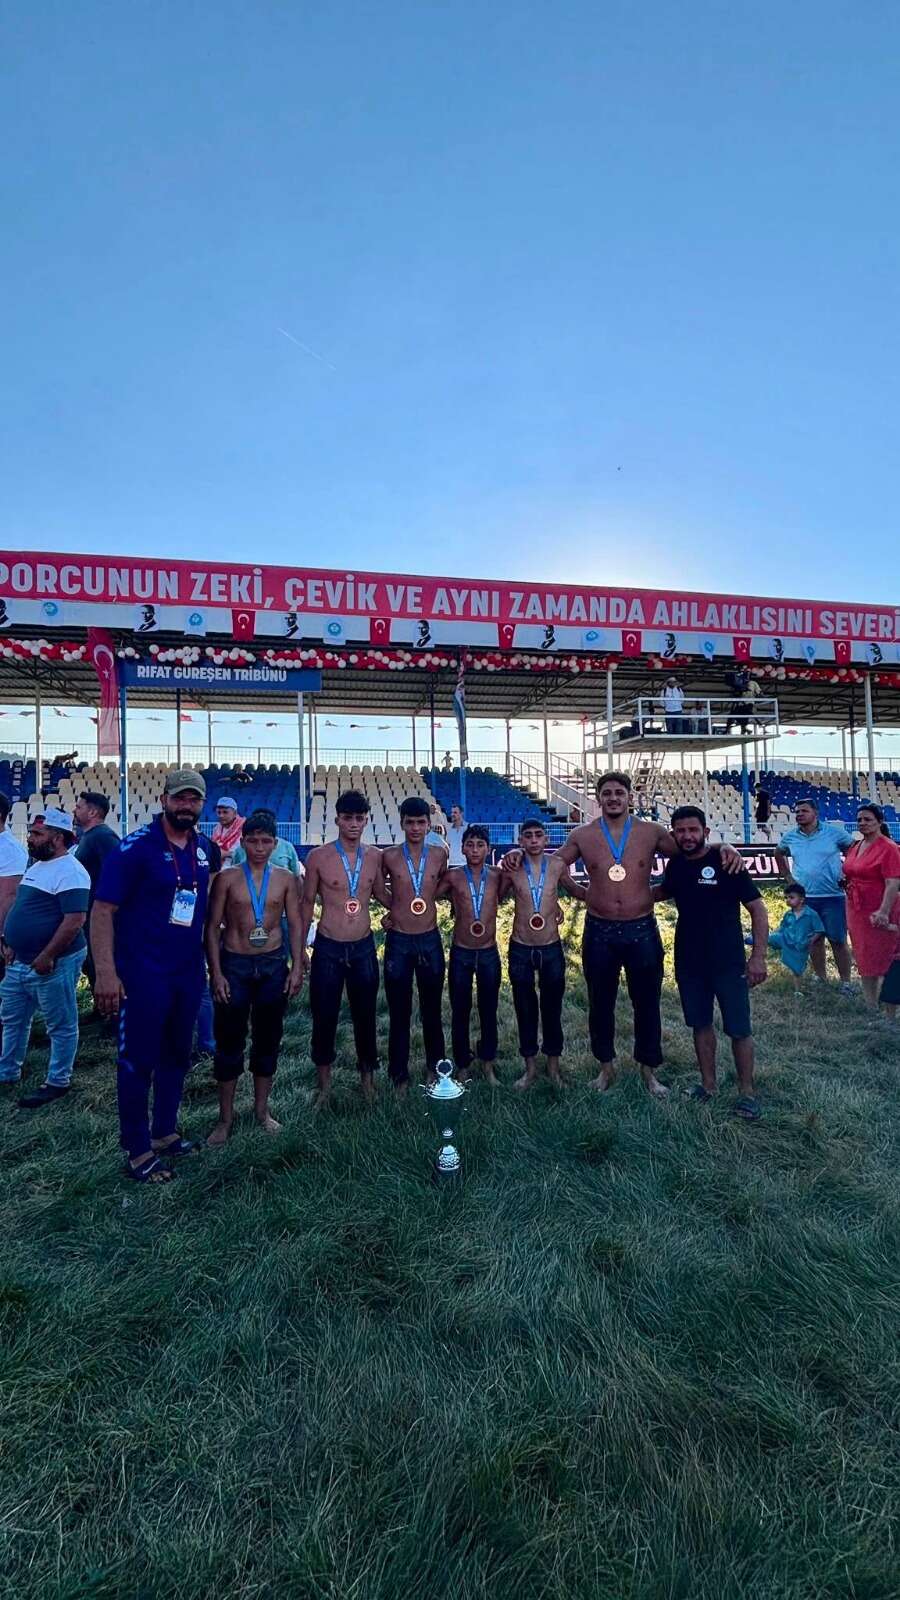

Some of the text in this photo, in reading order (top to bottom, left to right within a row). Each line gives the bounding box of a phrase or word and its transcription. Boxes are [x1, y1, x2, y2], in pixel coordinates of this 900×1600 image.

[190, 568, 274, 609] ZEKİ,
[284, 574, 378, 612] ÇEVİK
[386, 585, 423, 614] VE
[431, 587, 499, 617] AYNI
[508, 592, 645, 625] ZAMANDA
[652, 600, 812, 633] AHLAKLISINI
[137, 665, 171, 679] RIFAT
